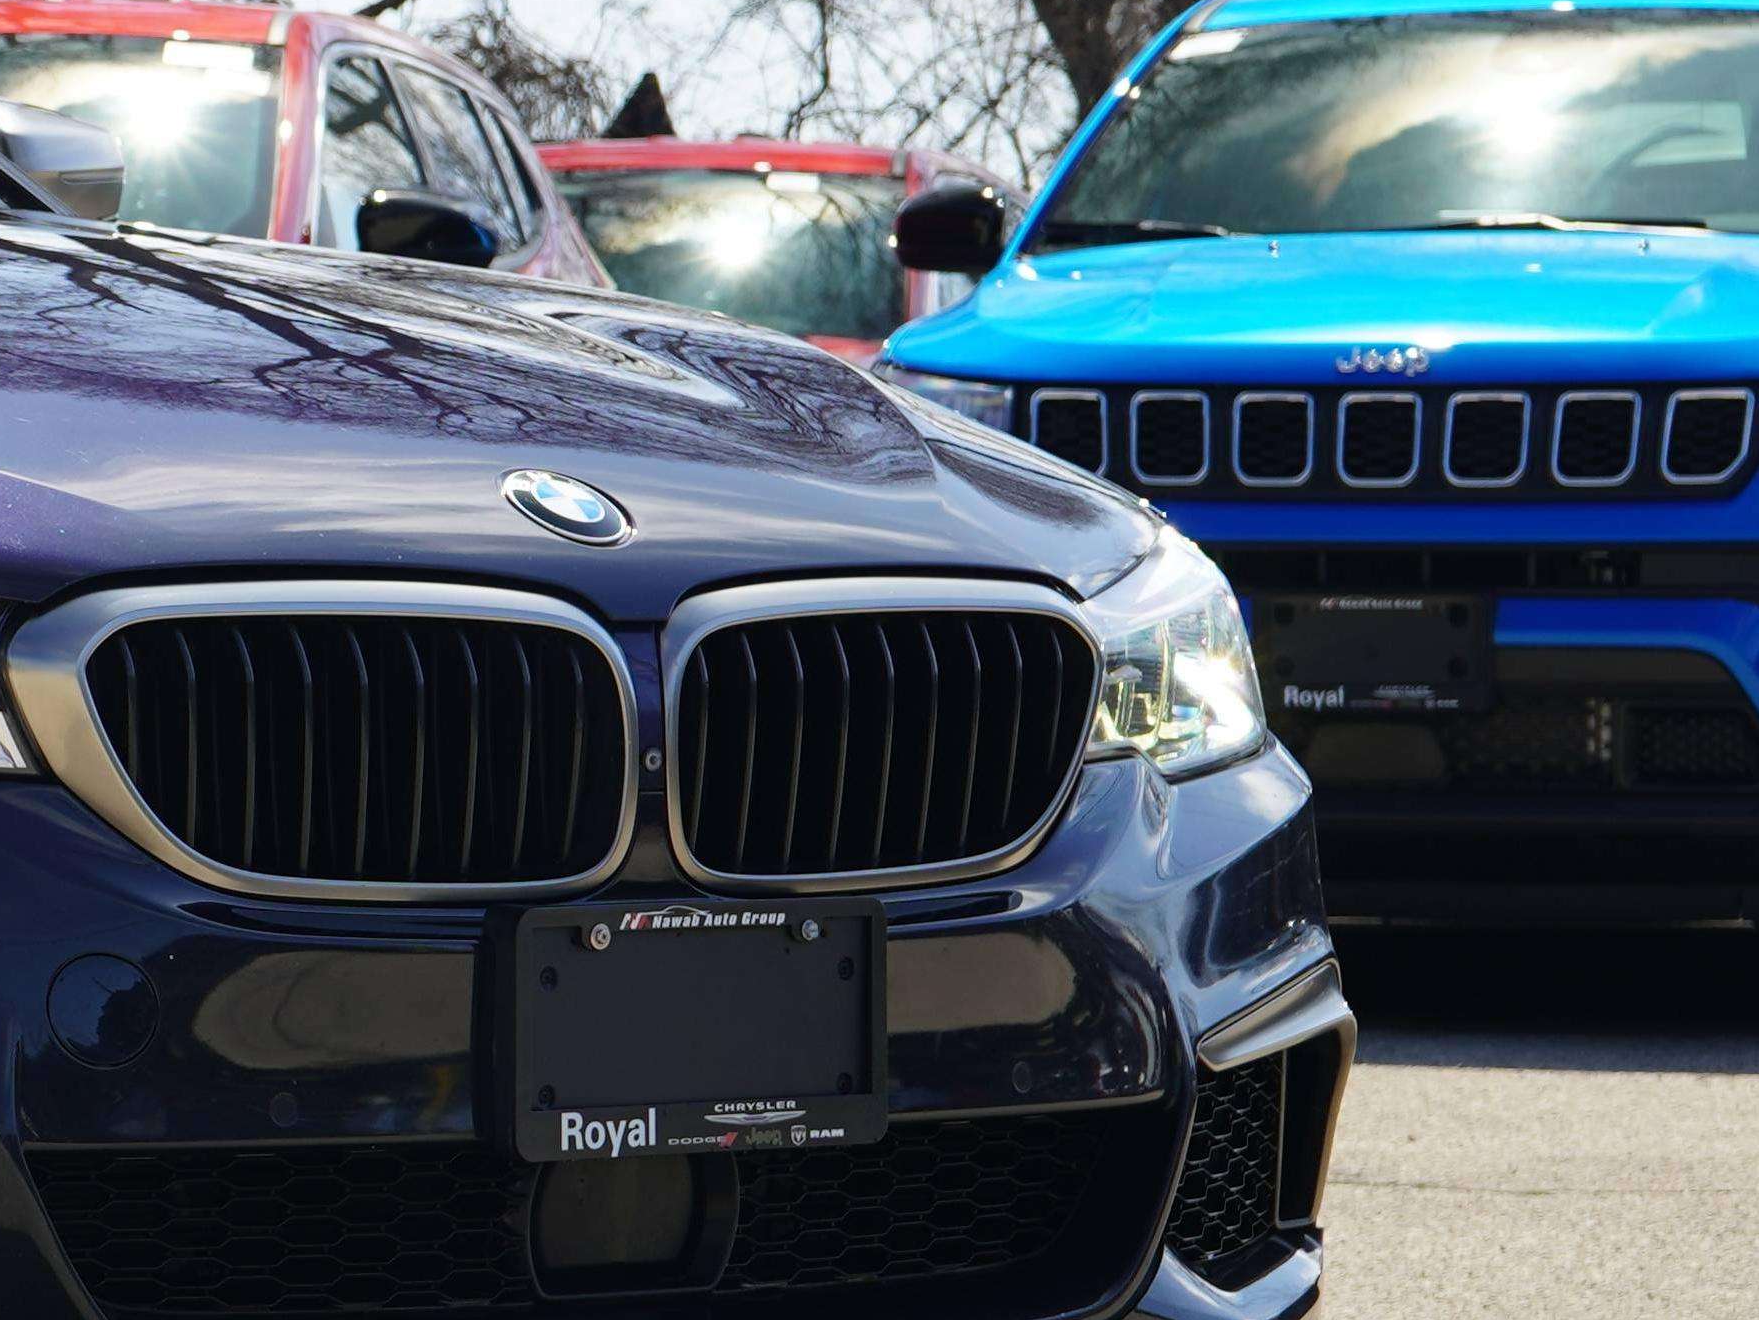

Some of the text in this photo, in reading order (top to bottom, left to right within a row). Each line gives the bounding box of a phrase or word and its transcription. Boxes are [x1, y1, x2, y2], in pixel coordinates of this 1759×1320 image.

[1336, 346, 1430, 377] Jeep
[1284, 684, 1344, 712] Royal
[652, 913, 701, 929] Nawab
[703, 912, 737, 927] Auto
[741, 911, 786, 926] Group
[714, 1100, 797, 1113] CHRYSLER
[561, 1107, 657, 1158] Royal
[810, 1128, 845, 1139] RAM
